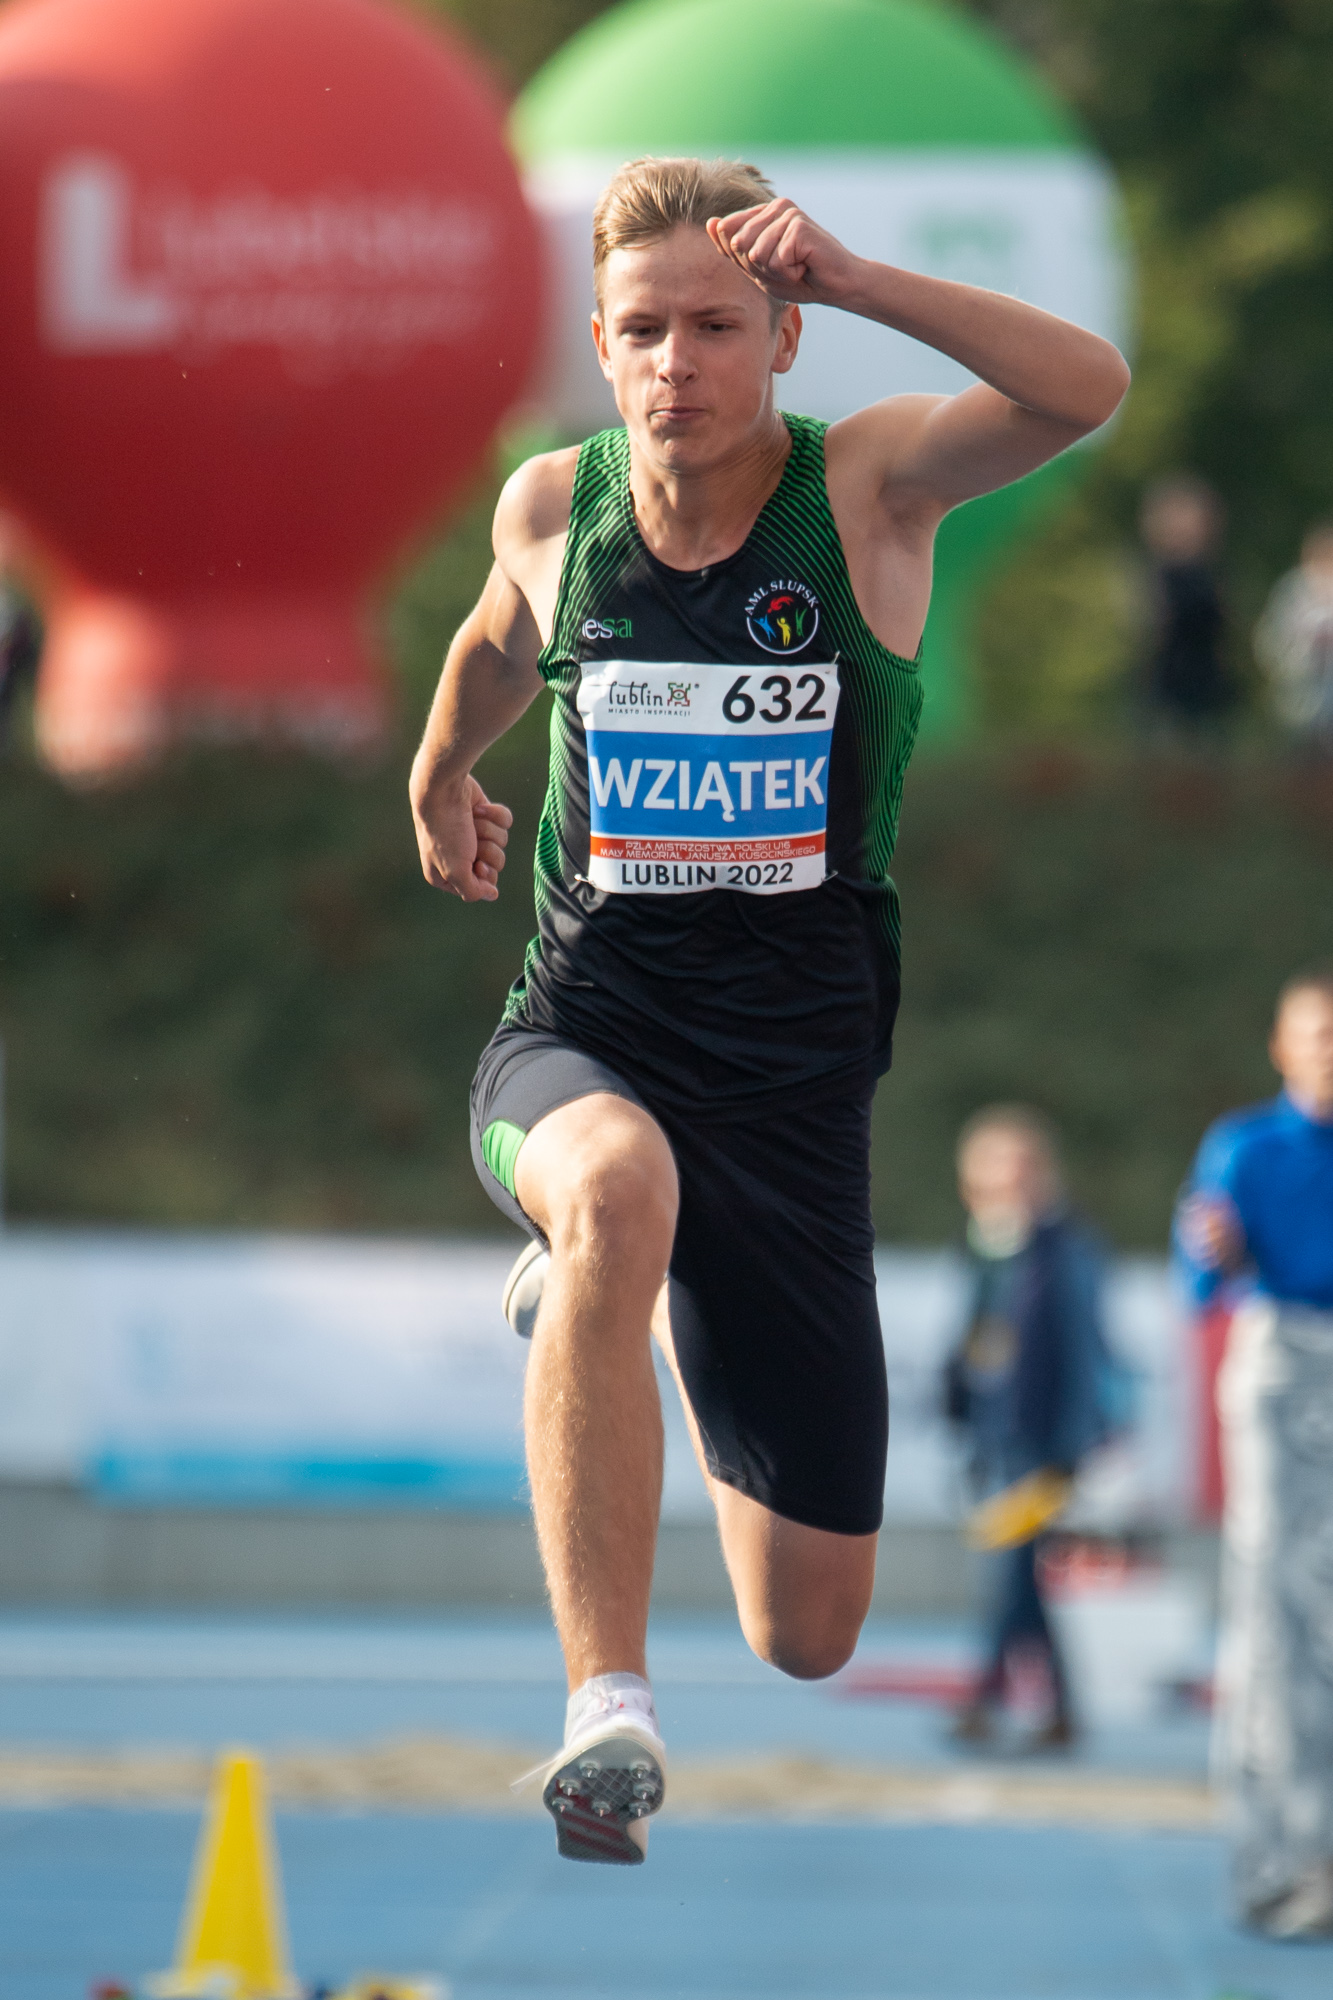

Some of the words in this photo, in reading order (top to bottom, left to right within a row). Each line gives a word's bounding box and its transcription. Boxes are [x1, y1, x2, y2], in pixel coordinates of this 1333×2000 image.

[744, 587, 769, 616] AML
[722, 673, 827, 724] 632
[643, 709, 691, 717] INSPIRACJI
[588, 756, 827, 823] WZIĄTEK
[625, 841, 653, 852] PZLA
[654, 842, 732, 853] MISTRZOSTWA
[734, 841, 771, 852] POLSKI
[685, 851, 737, 861] JANUSZA
[621, 863, 717, 887] LUBLIN
[727, 862, 794, 887] 2022
